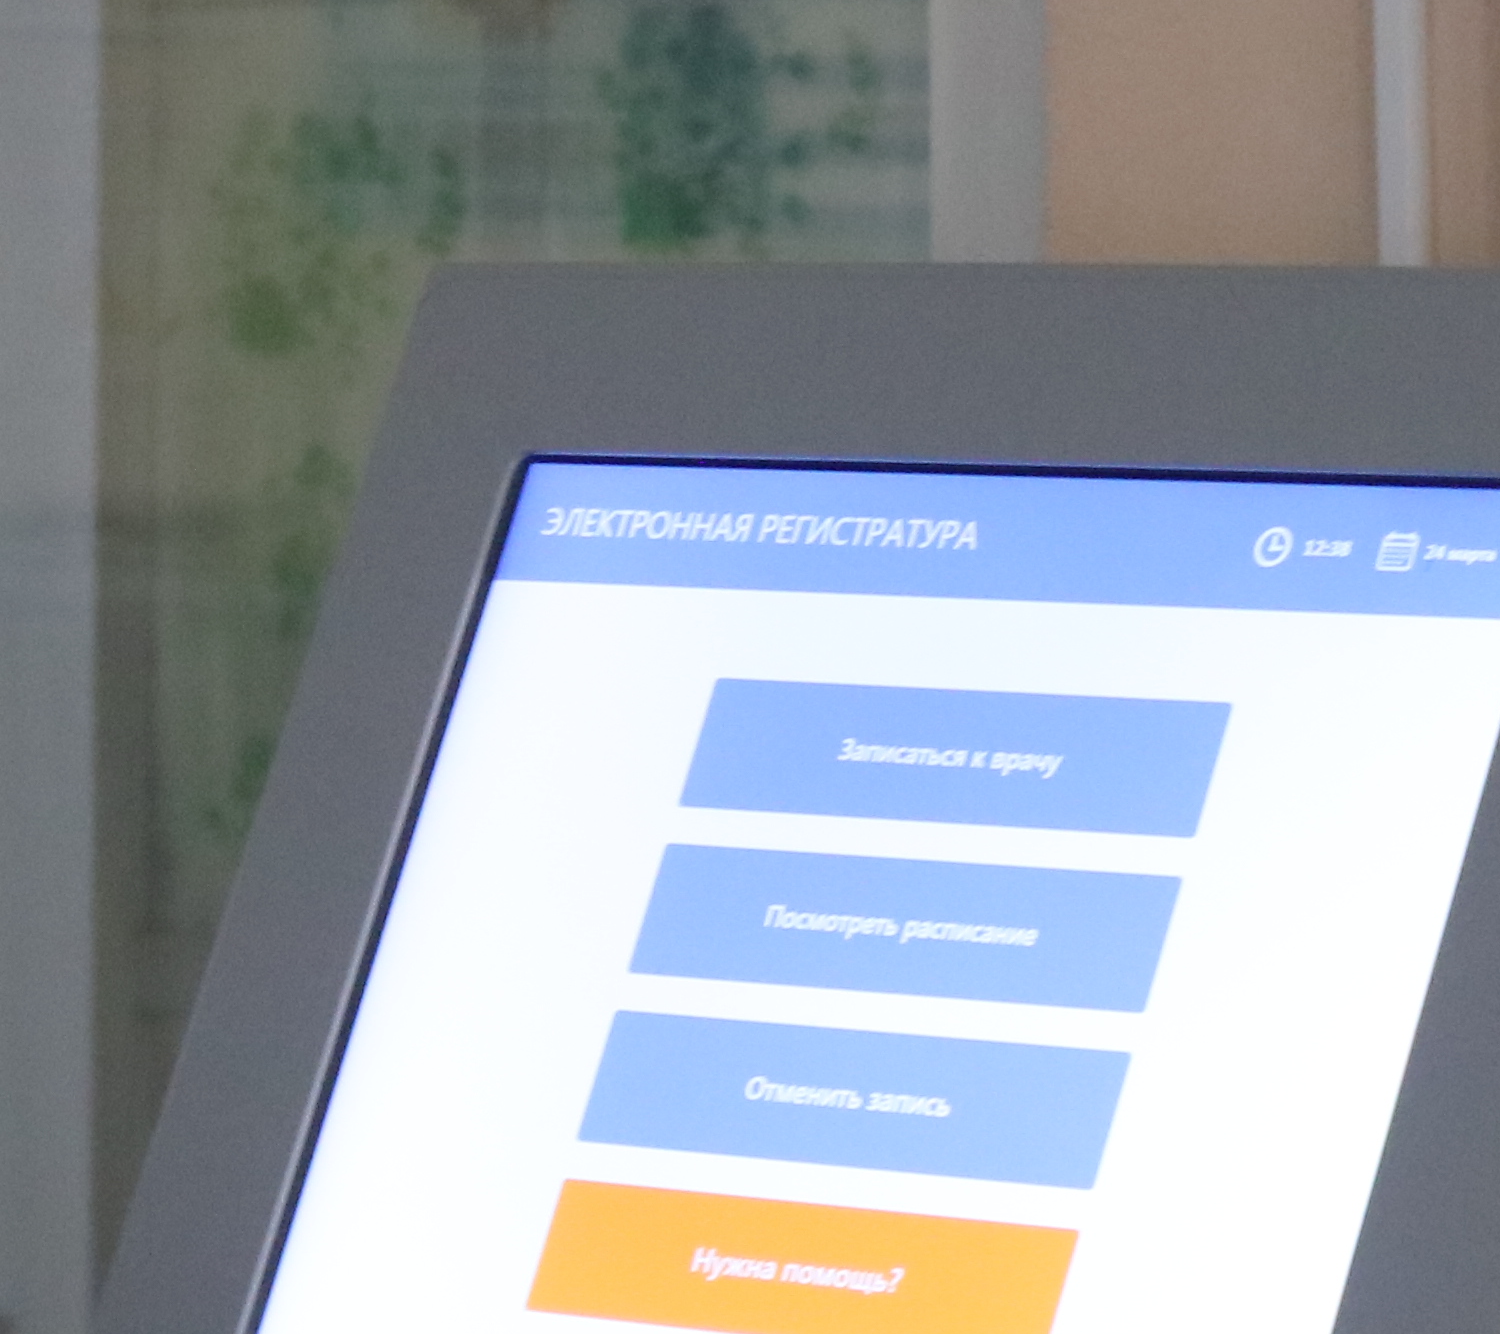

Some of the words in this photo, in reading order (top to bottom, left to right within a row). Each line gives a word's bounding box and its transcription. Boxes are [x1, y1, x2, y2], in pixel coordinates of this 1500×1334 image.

[540, 506, 755, 543] ЭЛЕКТРОННАЯ
[756, 513, 980, 551] РЕГИСТРАТУРА
[836, 737, 970, 767] Записаться
[970, 750, 990, 768] к
[989, 751, 1064, 780] врачу
[763, 903, 900, 940] Посмотреть
[899, 919, 1039, 947] расписание
[744, 1075, 864, 1110] Отменить
[864, 1091, 952, 1118] запись
[689, 1246, 778, 1282] Нужна
[778, 1262, 906, 1295] помощь?
